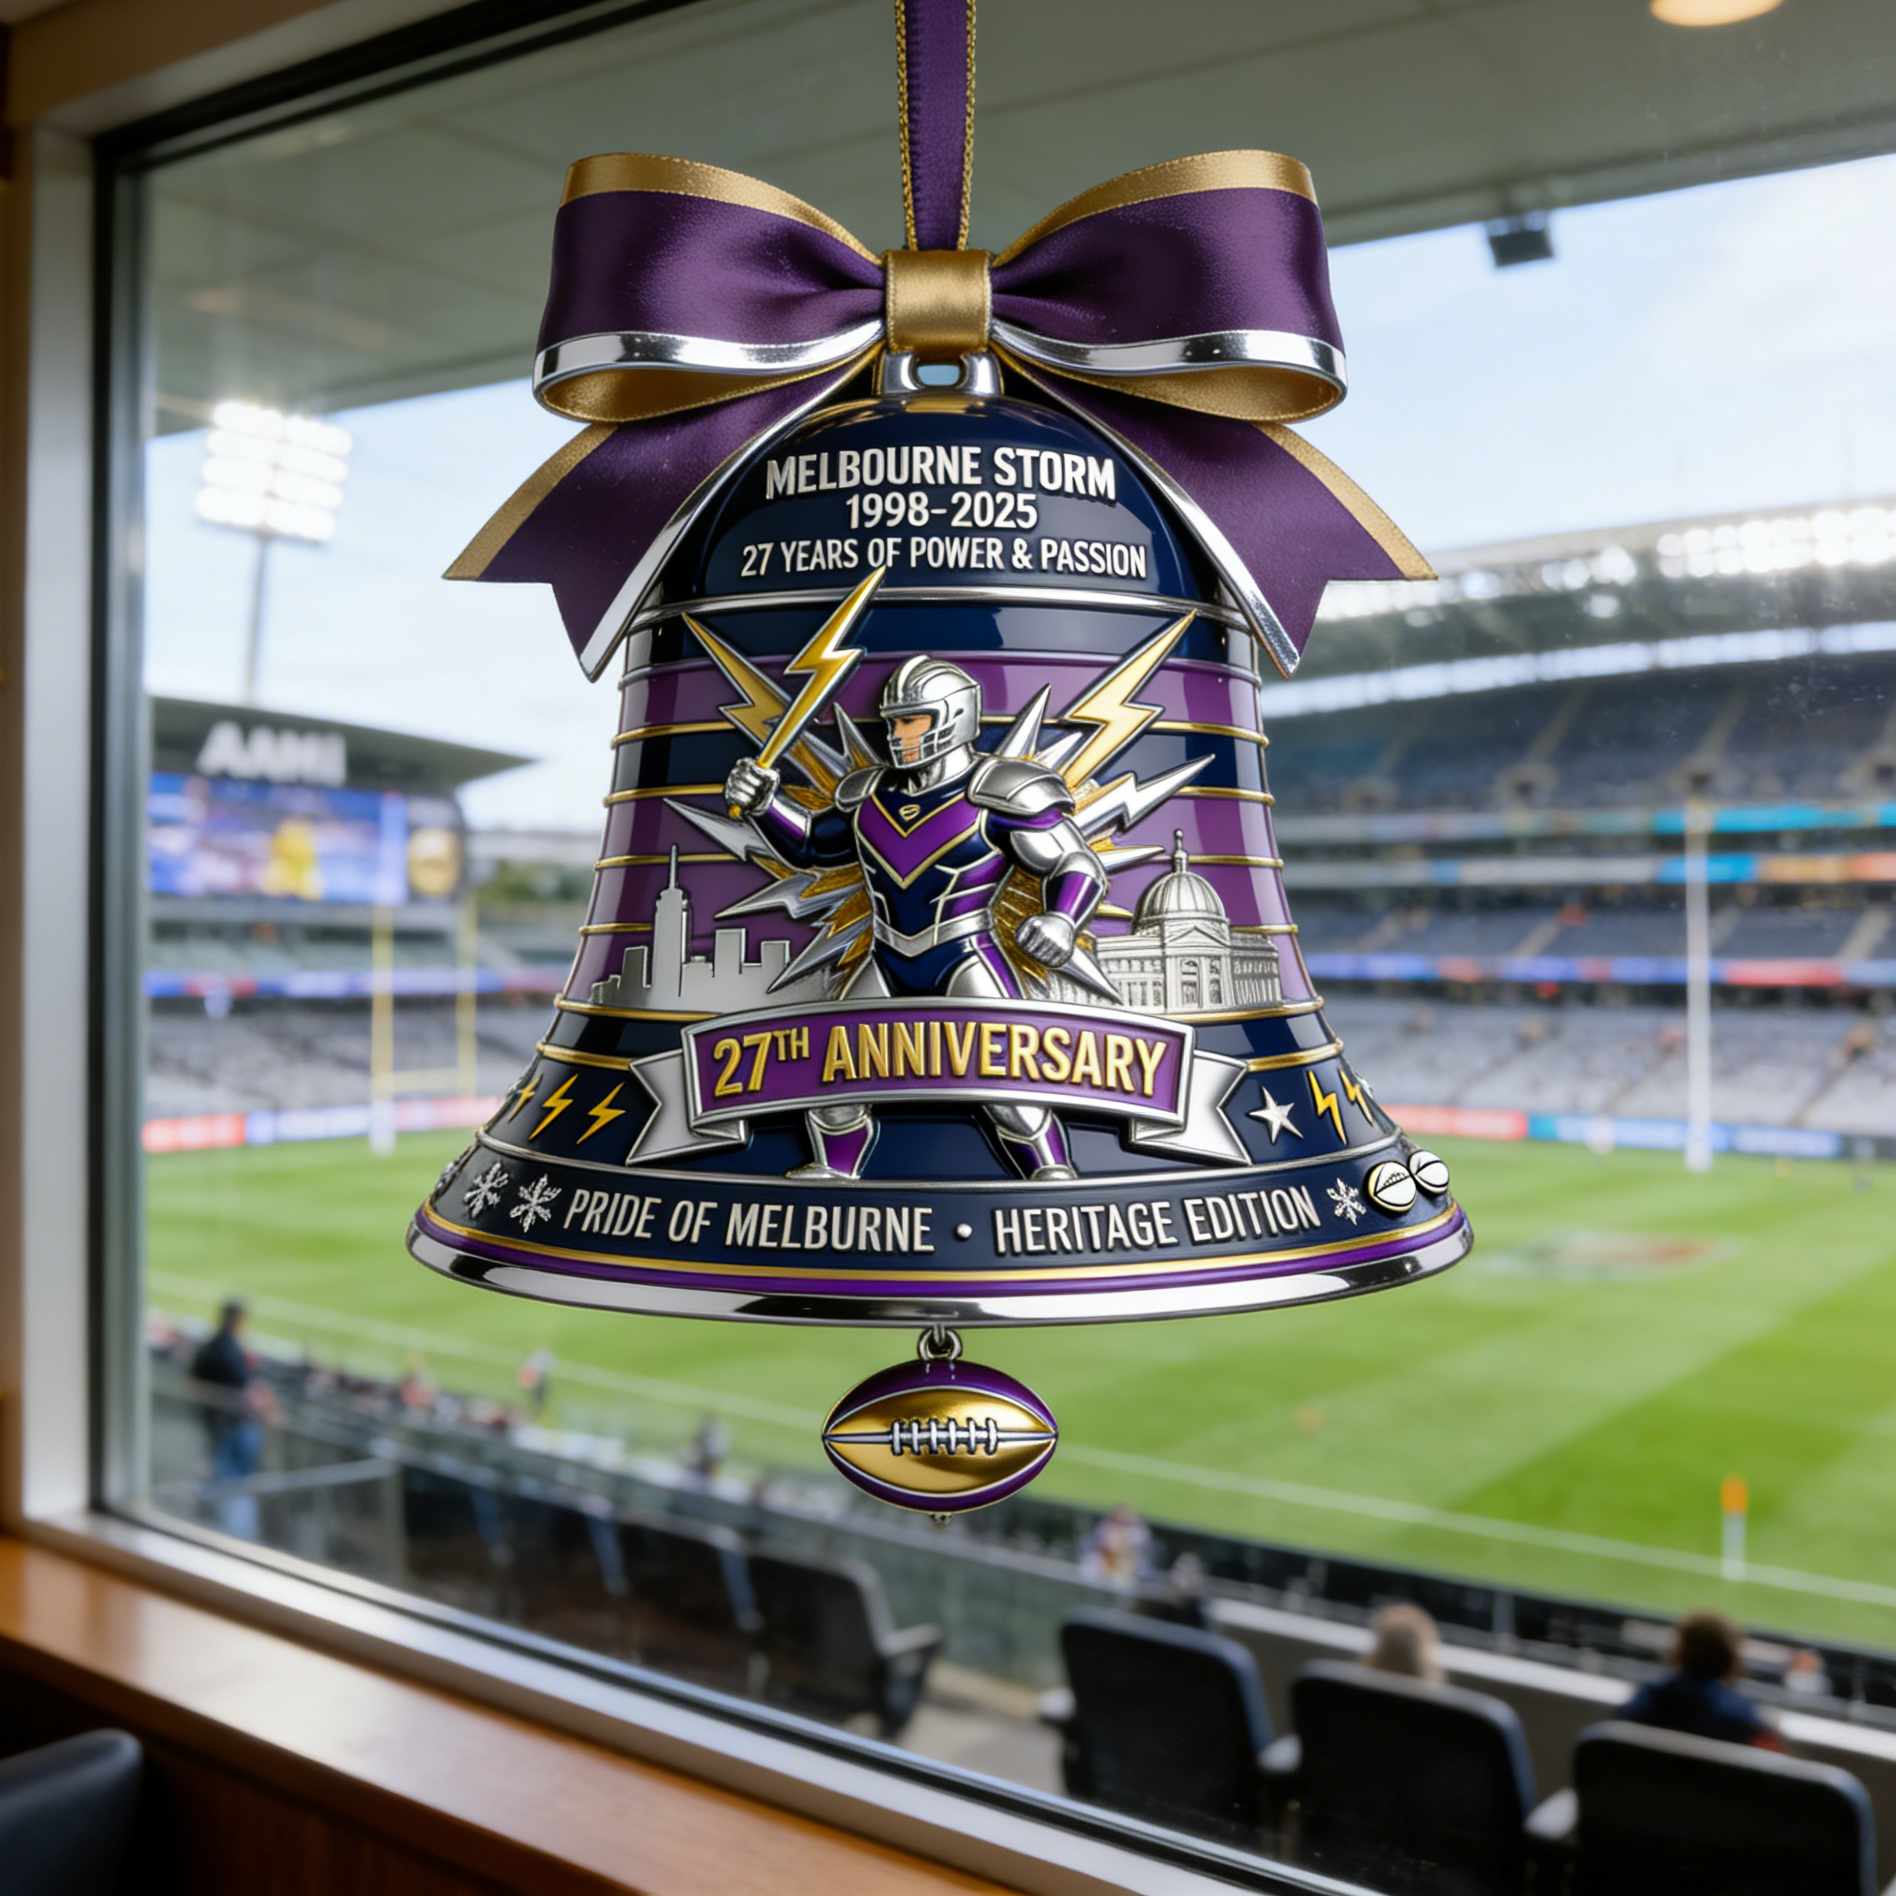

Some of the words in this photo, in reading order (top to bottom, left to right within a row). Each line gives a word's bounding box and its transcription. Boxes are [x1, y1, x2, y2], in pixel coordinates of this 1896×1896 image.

[766, 445, 982, 498] MELBOURNE
[993, 447, 1116, 500] STORM
[846, 492, 1038, 529] 1998-2025
[740, 542, 774, 577] 27
[780, 539, 859, 573] YEARS
[868, 537, 902, 570] OF
[910, 537, 1004, 570] POWER
[1011, 540, 1033, 571] &
[1041, 540, 1147, 578] PASSION
[822, 1021, 1167, 1096] ANNIVERSARY
[563, 1188, 662, 1239] PRIDE
[668, 1200, 717, 1244] OF
[725, 1203, 935, 1253] MELBURNE
[994, 1200, 1179, 1256] HERITAGE
[1184, 1184, 1322, 1242] EDITION
